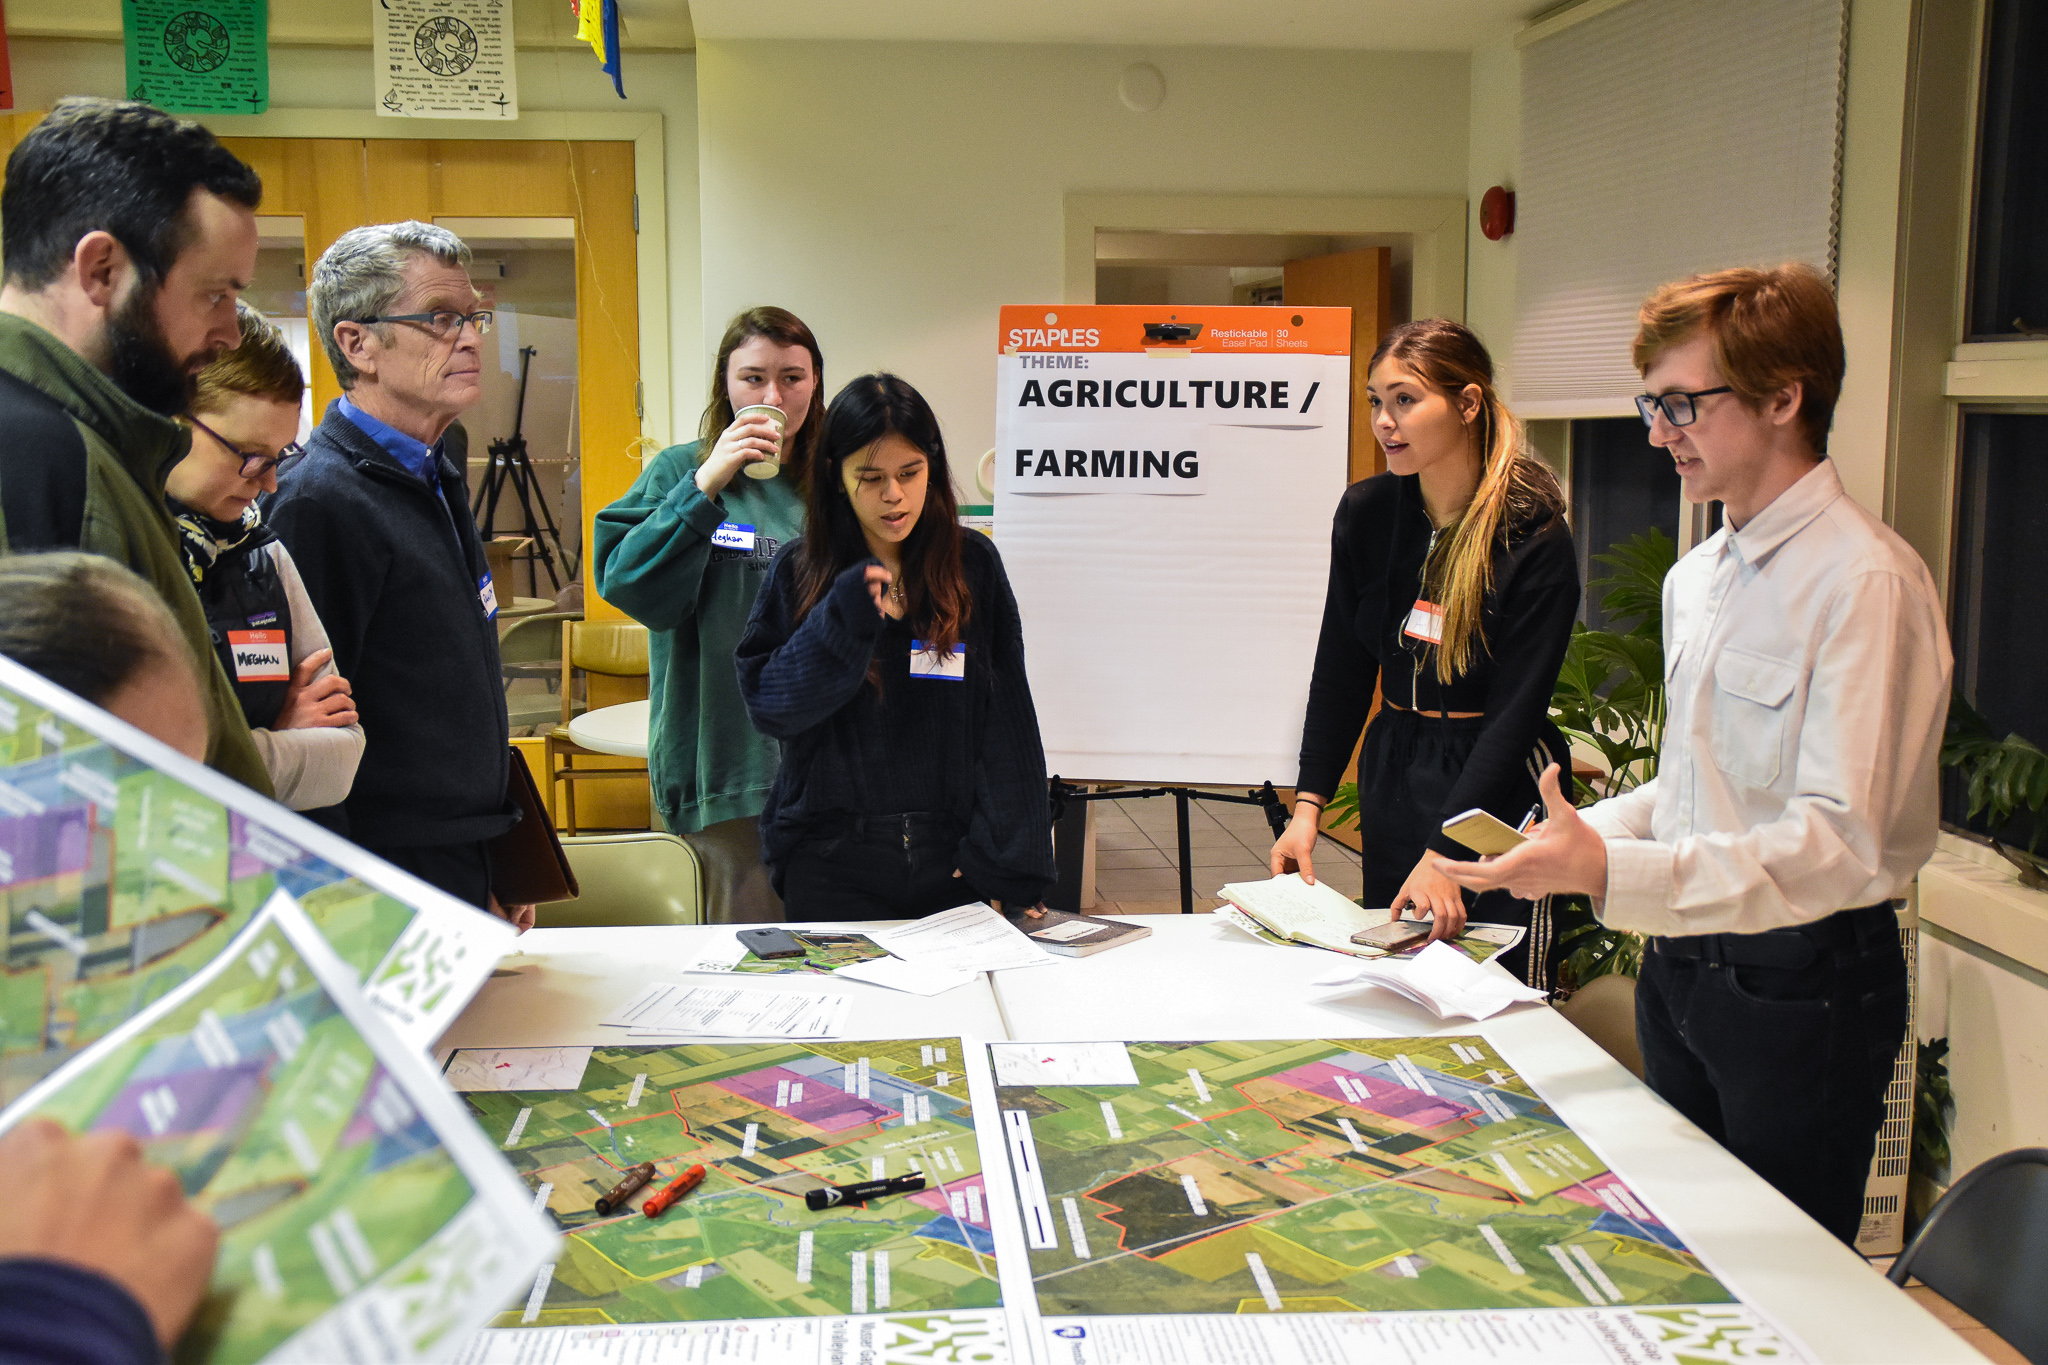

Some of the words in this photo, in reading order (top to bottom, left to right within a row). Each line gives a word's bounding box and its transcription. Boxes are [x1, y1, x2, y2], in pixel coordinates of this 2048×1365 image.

[1009, 328, 1100, 347] STAPLES
[1210, 328, 1268, 339] Restickable
[1276, 329, 1289, 338] 30
[1221, 338, 1247, 348] Easel
[1250, 338, 1268, 348] Pad
[1276, 338, 1308, 348] Sheets
[1019, 355, 1089, 369] THEME:
[1018, 379, 1289, 409] AGRICULTURE
[1015, 448, 1199, 479] FARMING
[236, 651, 280, 667] MEGHAN
